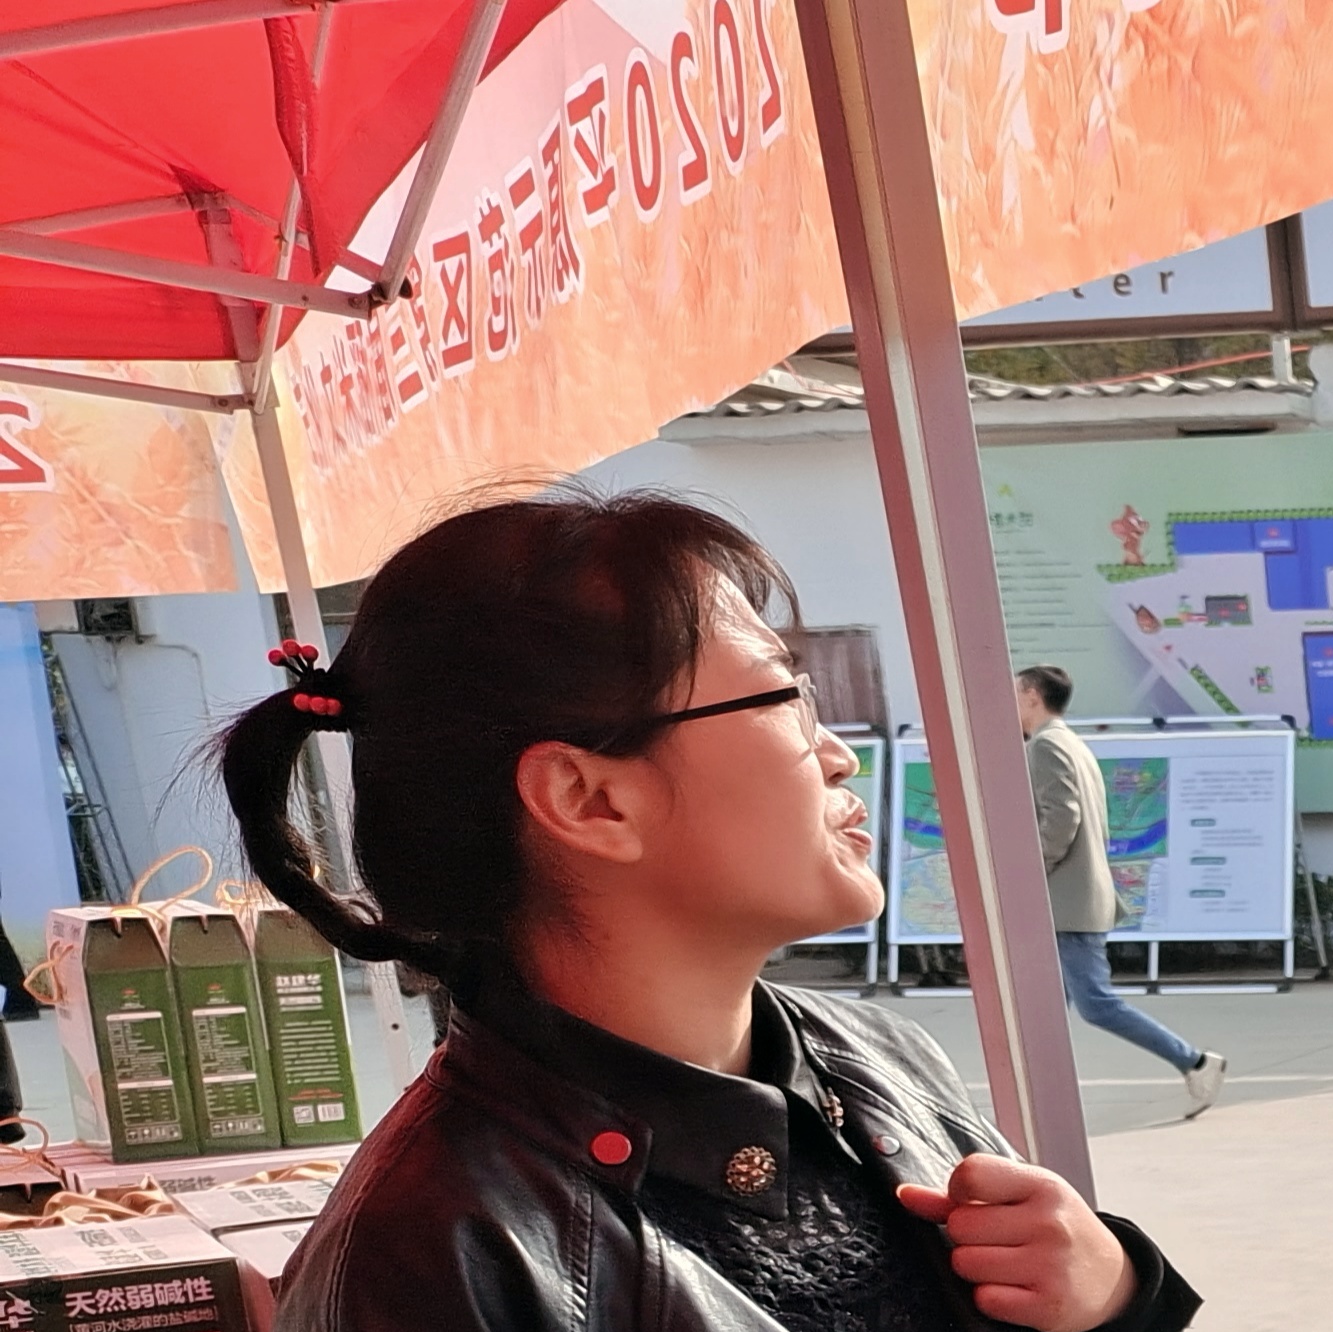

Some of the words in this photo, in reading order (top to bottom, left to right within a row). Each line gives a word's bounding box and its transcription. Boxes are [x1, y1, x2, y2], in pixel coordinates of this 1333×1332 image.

[65, 1275, 215, 1318] 天然弱碱性
